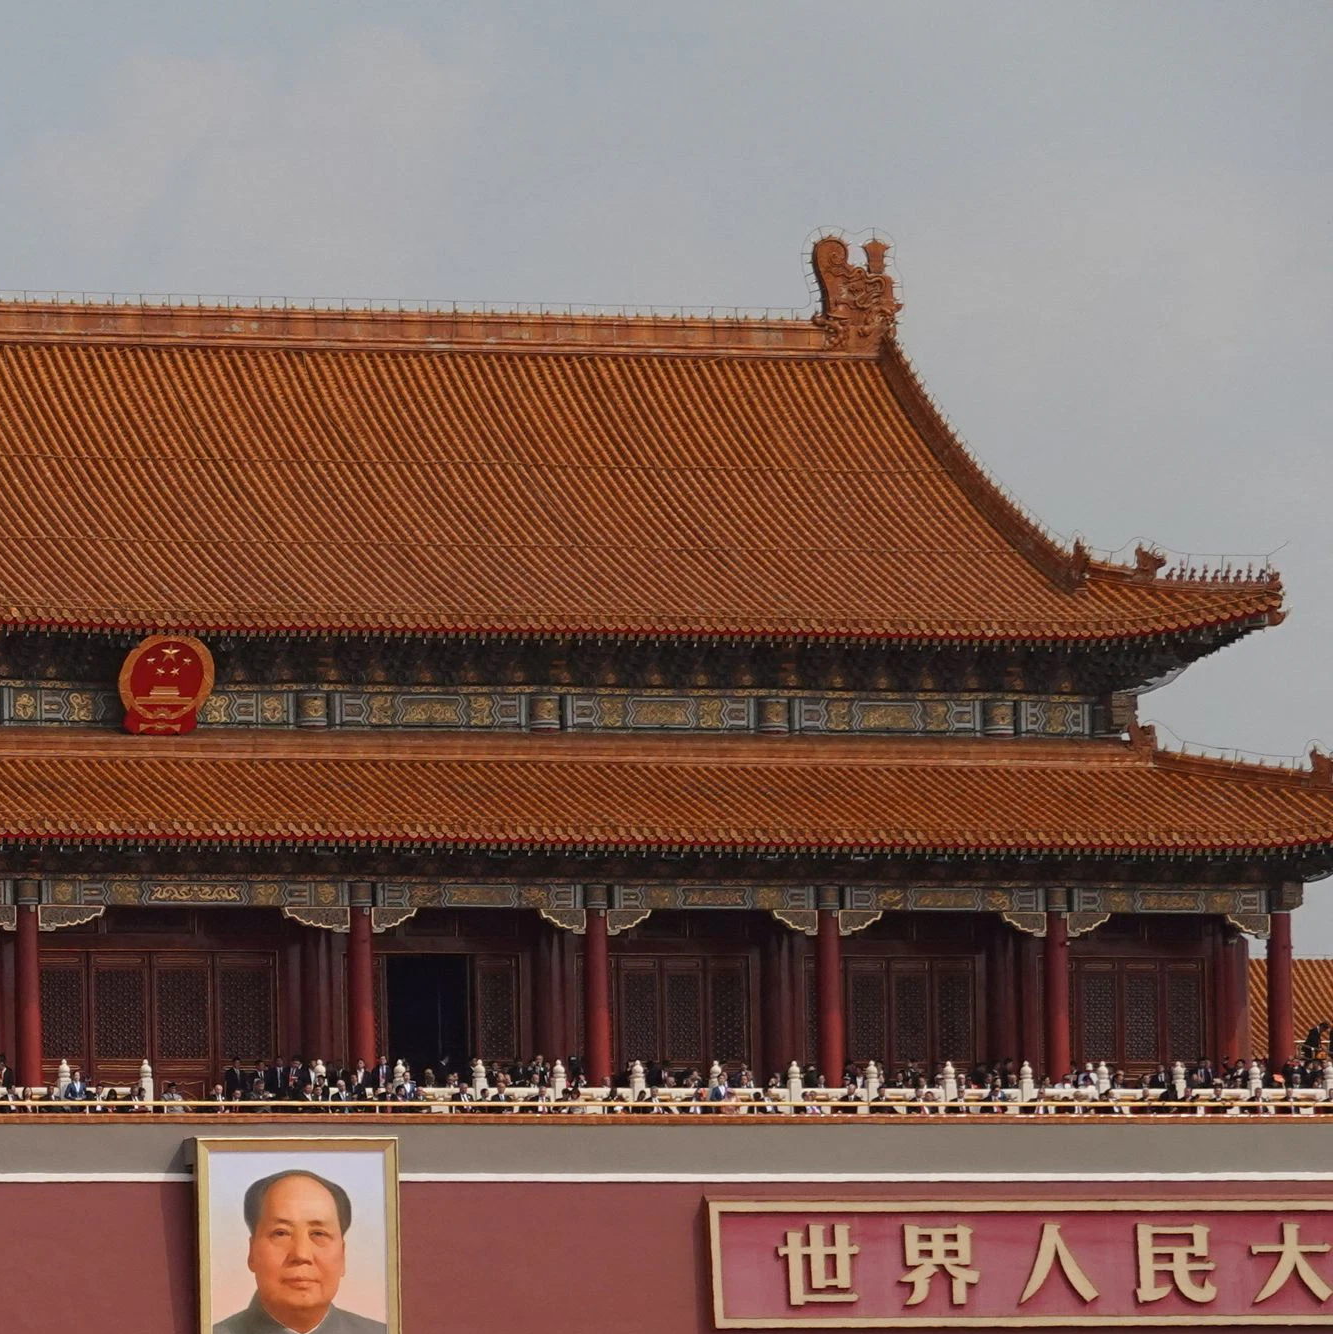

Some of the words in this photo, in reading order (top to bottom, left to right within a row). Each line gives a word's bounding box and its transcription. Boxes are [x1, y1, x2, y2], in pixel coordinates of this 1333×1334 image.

[777, 1222, 1333, 1306] 世界人民大
